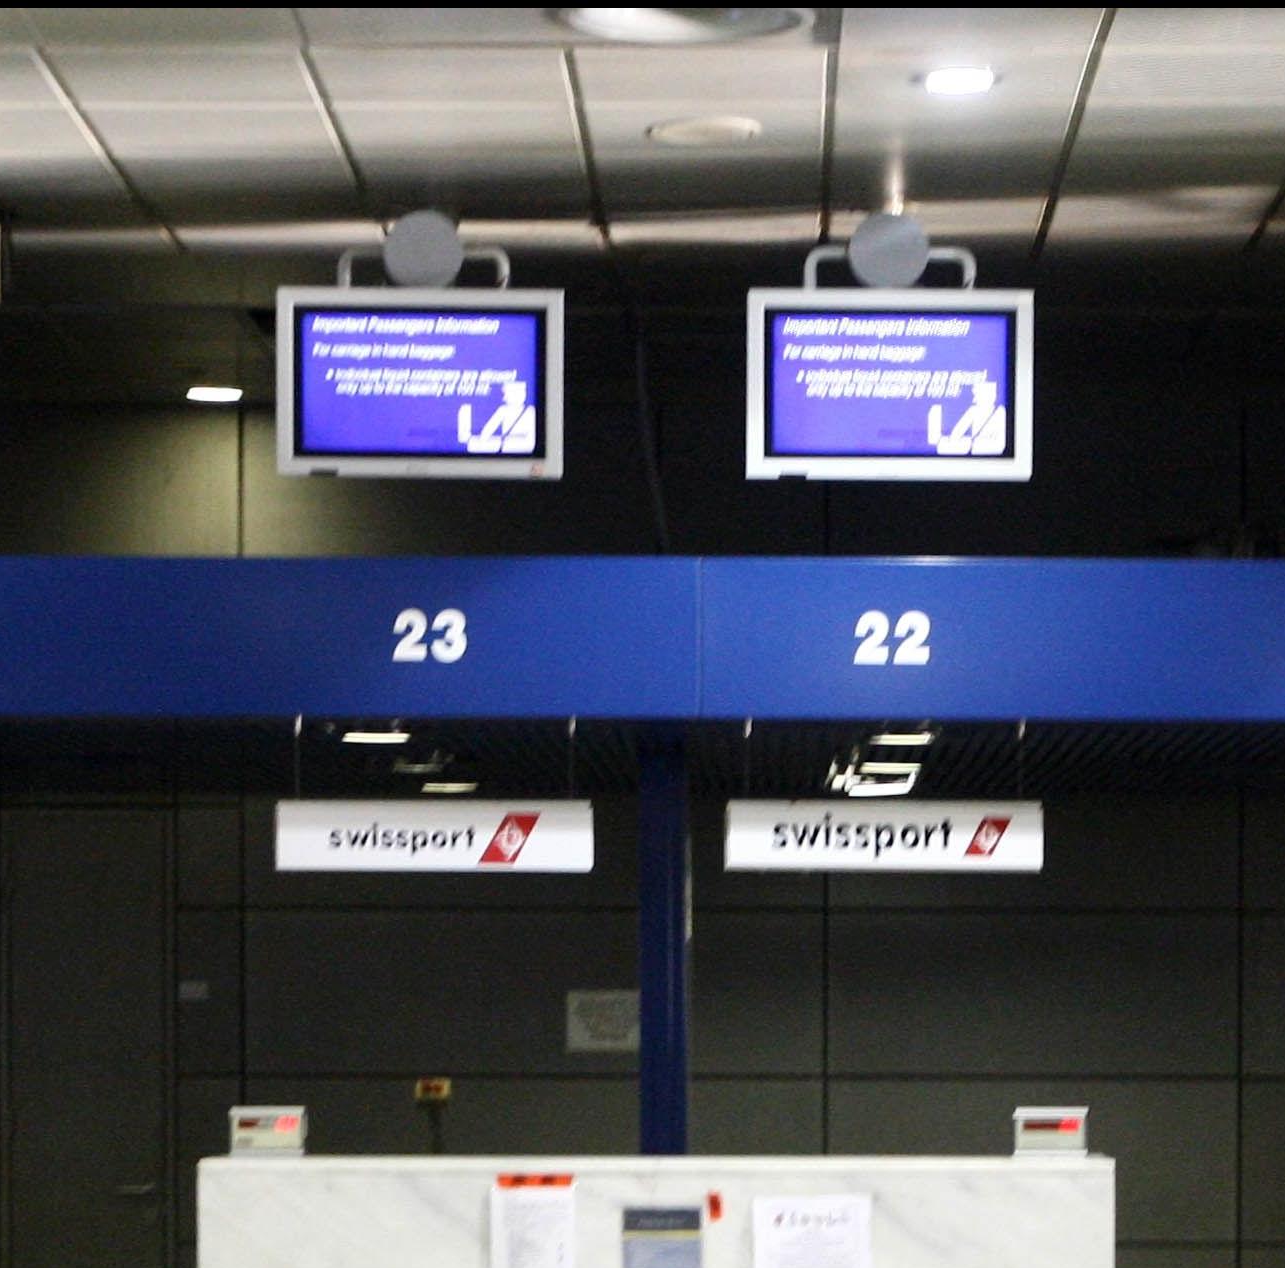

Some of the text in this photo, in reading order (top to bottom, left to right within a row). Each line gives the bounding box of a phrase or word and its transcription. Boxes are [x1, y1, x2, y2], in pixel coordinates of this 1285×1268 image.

[392, 608, 468, 663] 23
[852, 609, 932, 666] 22
[329, 822, 475, 854] swissport
[772, 811, 952, 857] swissport
